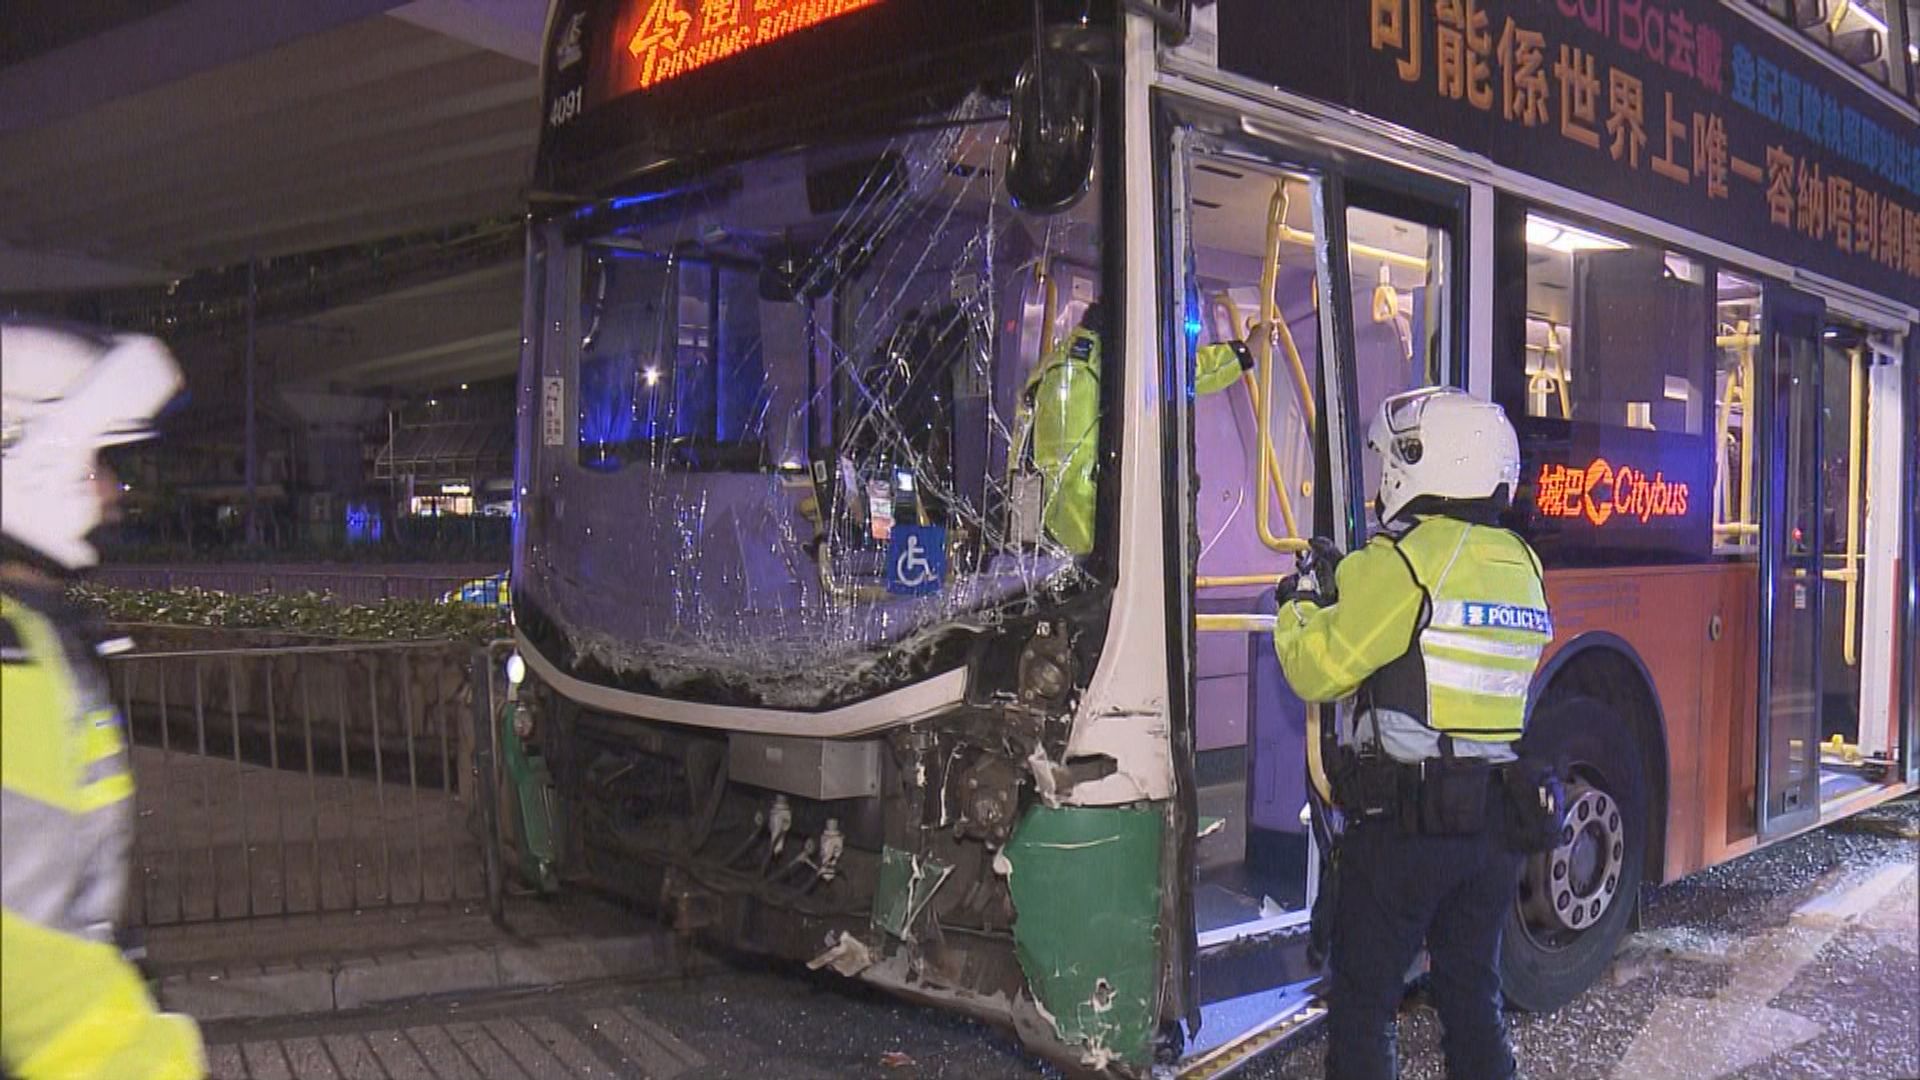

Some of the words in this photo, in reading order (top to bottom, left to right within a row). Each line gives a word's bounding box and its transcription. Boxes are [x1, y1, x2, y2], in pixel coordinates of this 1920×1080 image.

[550, 85, 582, 127] 4091
[1537, 464, 1584, 516] 城巴
[1614, 466, 1688, 523] Citybus
